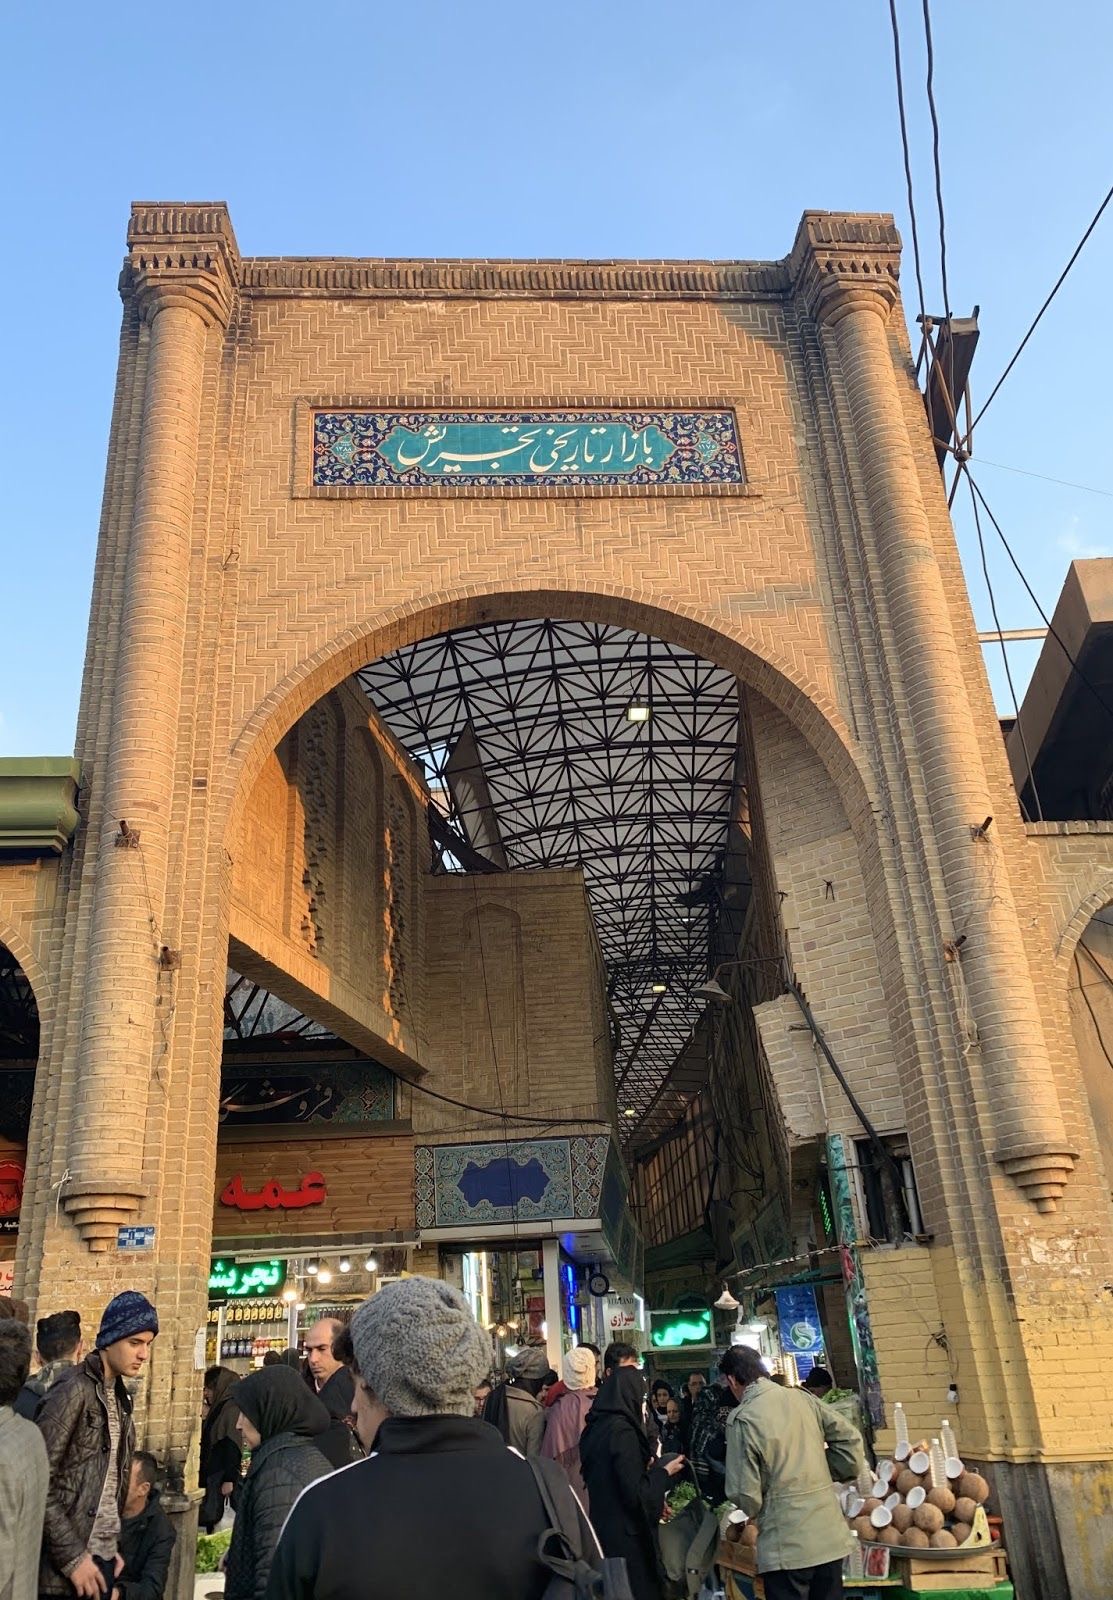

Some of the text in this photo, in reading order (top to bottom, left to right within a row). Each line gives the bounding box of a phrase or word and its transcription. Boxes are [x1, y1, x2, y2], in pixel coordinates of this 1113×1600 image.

[397, 425, 653, 473] بازار تاریخی تجریش
[221, 1171, 327, 1210] عمه
[610, 1310, 635, 1328] شیرازی
